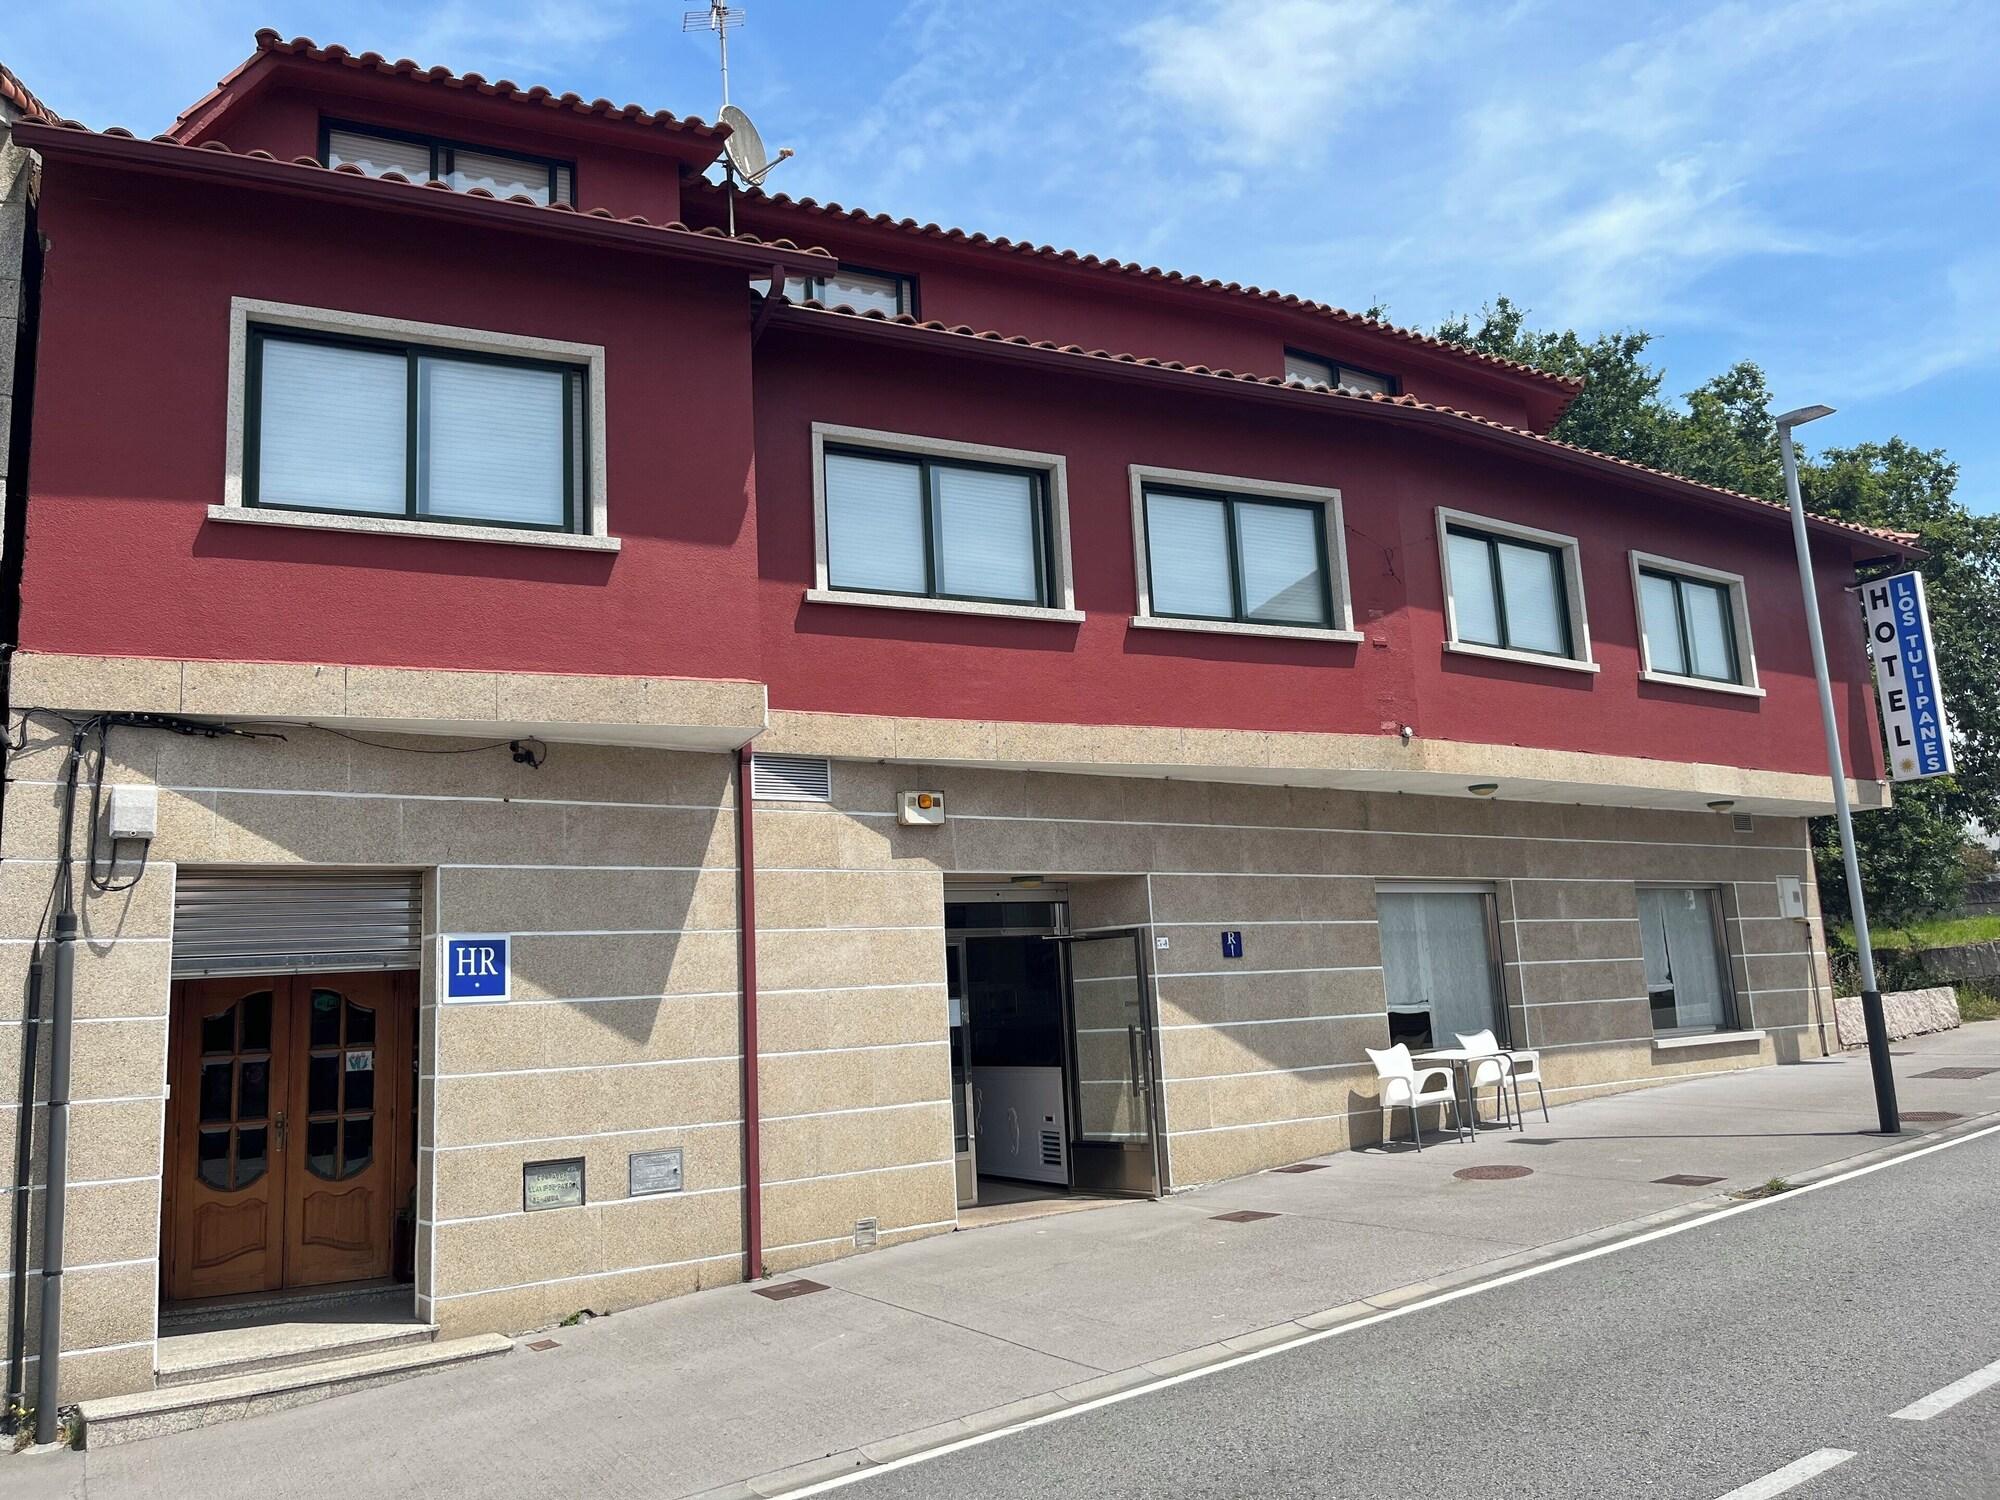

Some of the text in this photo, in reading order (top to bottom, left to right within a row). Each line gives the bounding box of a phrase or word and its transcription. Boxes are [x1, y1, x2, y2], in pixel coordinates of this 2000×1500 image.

[1869, 586, 1911, 747] HOTEL
[1897, 582, 1940, 771] LOS TULIPANES
[455, 947, 499, 976] HR
[1227, 931, 1237, 945] R
